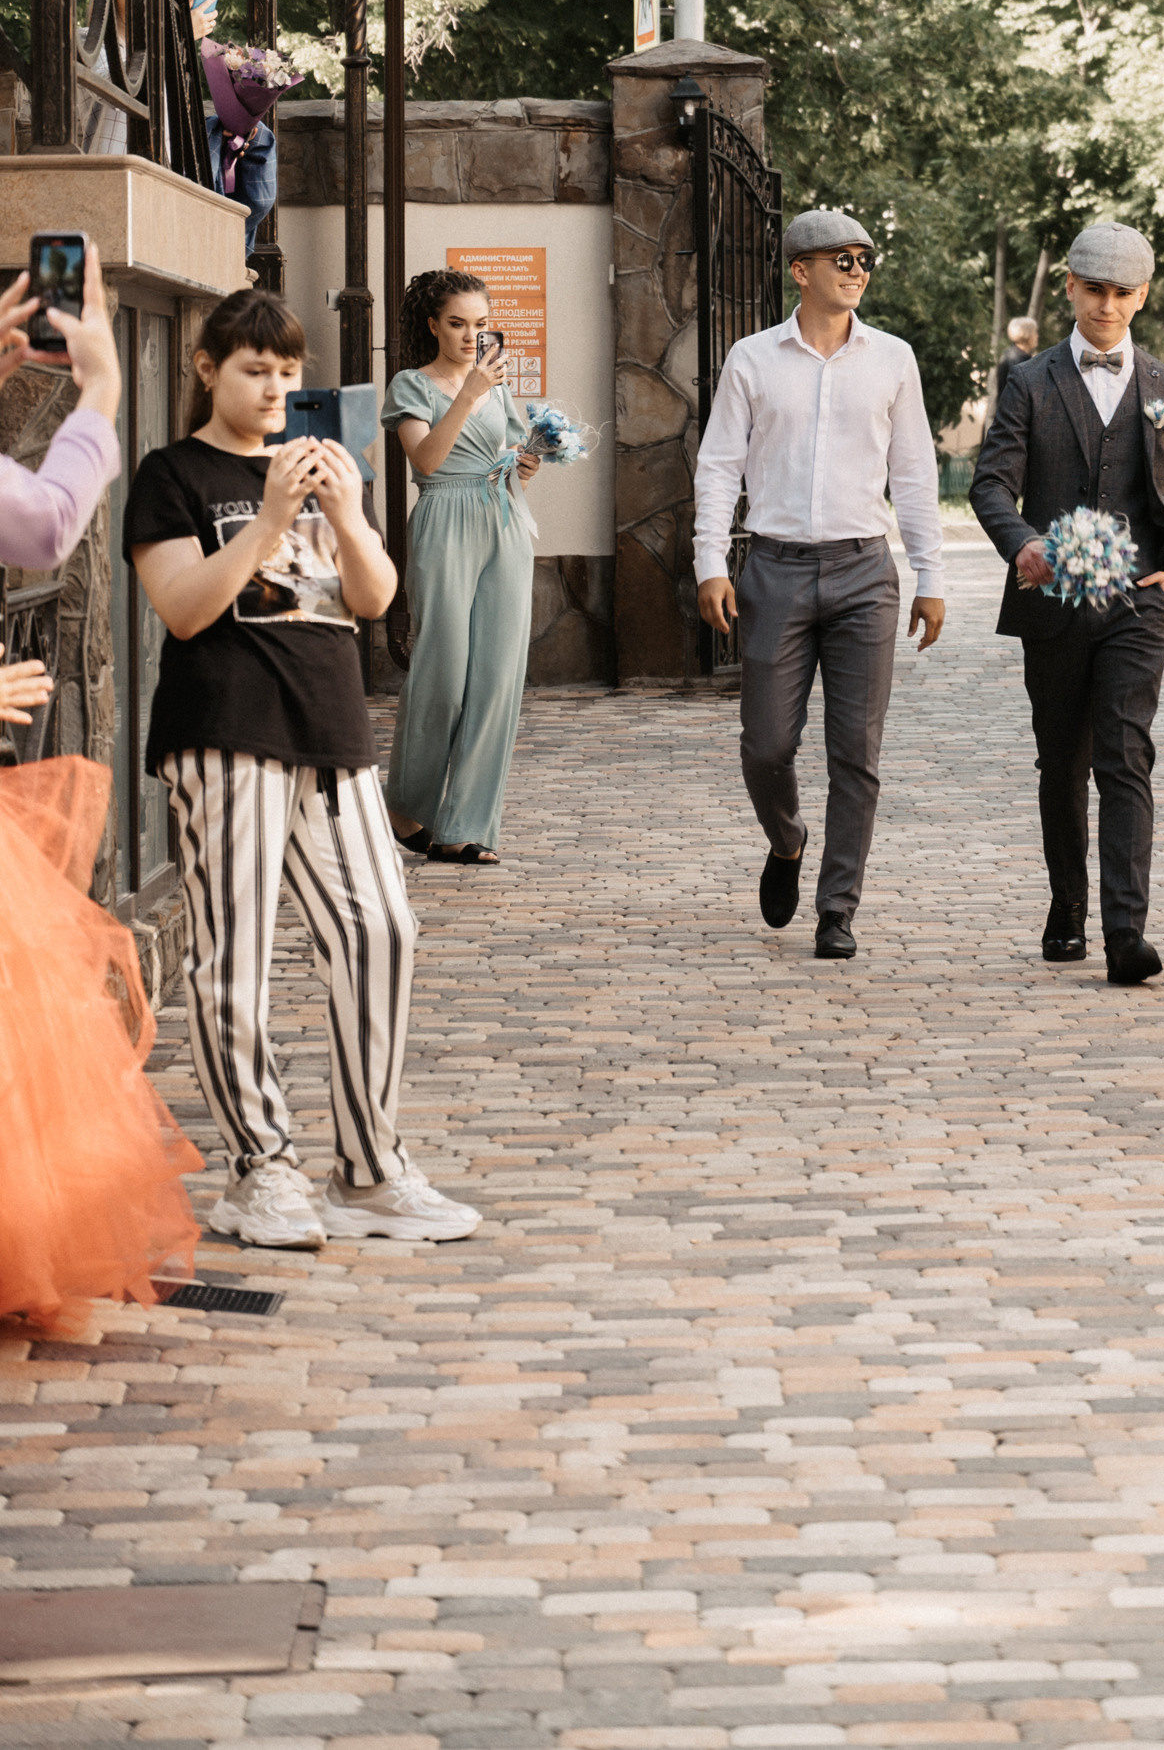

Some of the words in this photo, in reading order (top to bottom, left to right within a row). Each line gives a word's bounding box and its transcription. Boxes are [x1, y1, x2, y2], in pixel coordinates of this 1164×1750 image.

[459, 255, 534, 263] АДМИНИСТРАЦИЯ
[488, 298, 518, 308] ДЕТСЯ
[497, 321, 544, 329] УСТАНОВЛЕН
[208, 500, 254, 518] YOU
